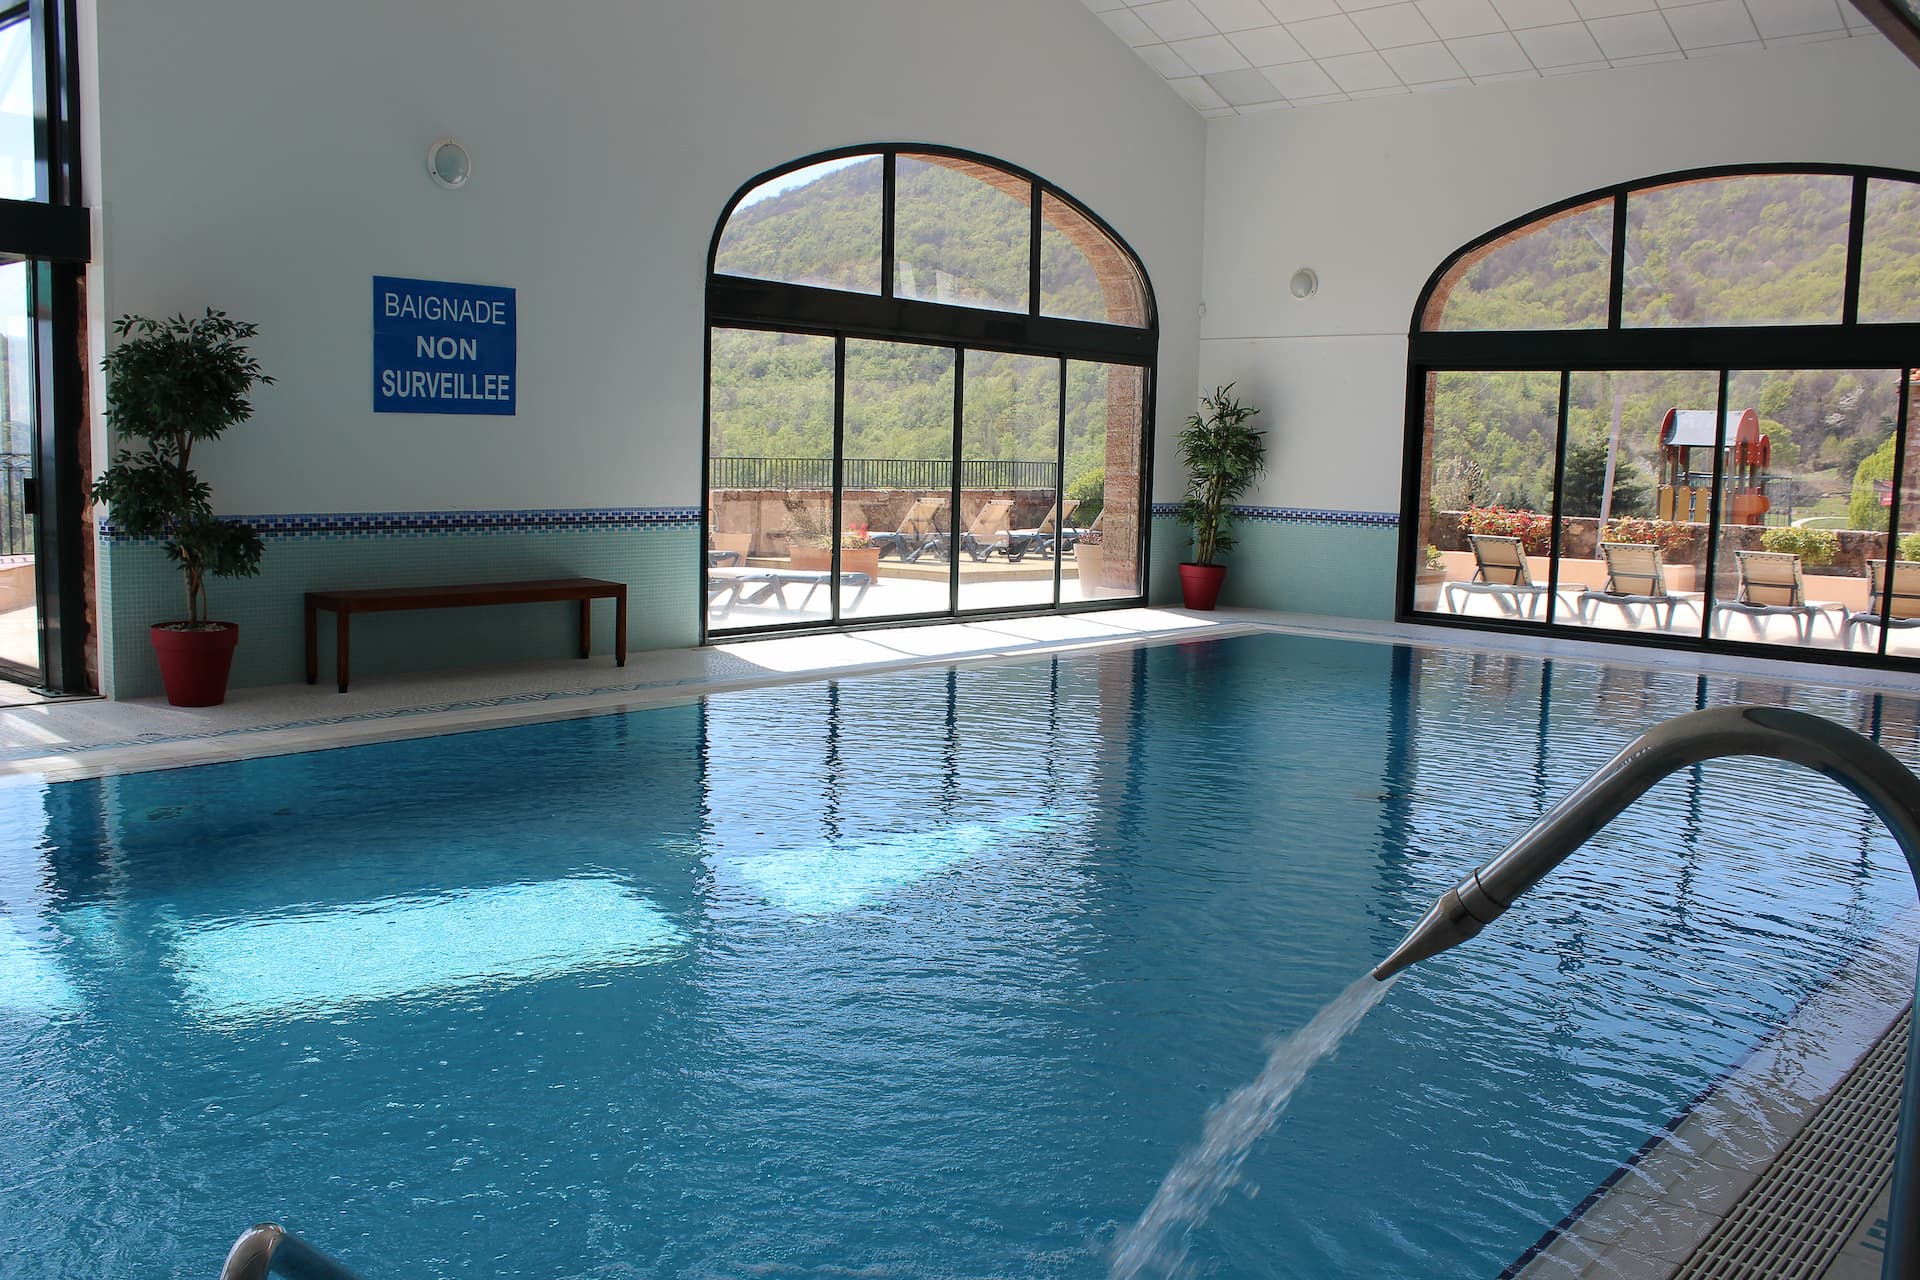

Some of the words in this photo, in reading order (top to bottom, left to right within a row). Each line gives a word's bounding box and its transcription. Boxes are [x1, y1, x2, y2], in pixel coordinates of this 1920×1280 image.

[385, 292, 506, 325] BAIGNADE
[416, 336, 477, 360] NON
[382, 369, 510, 400] SURVEILLEE
